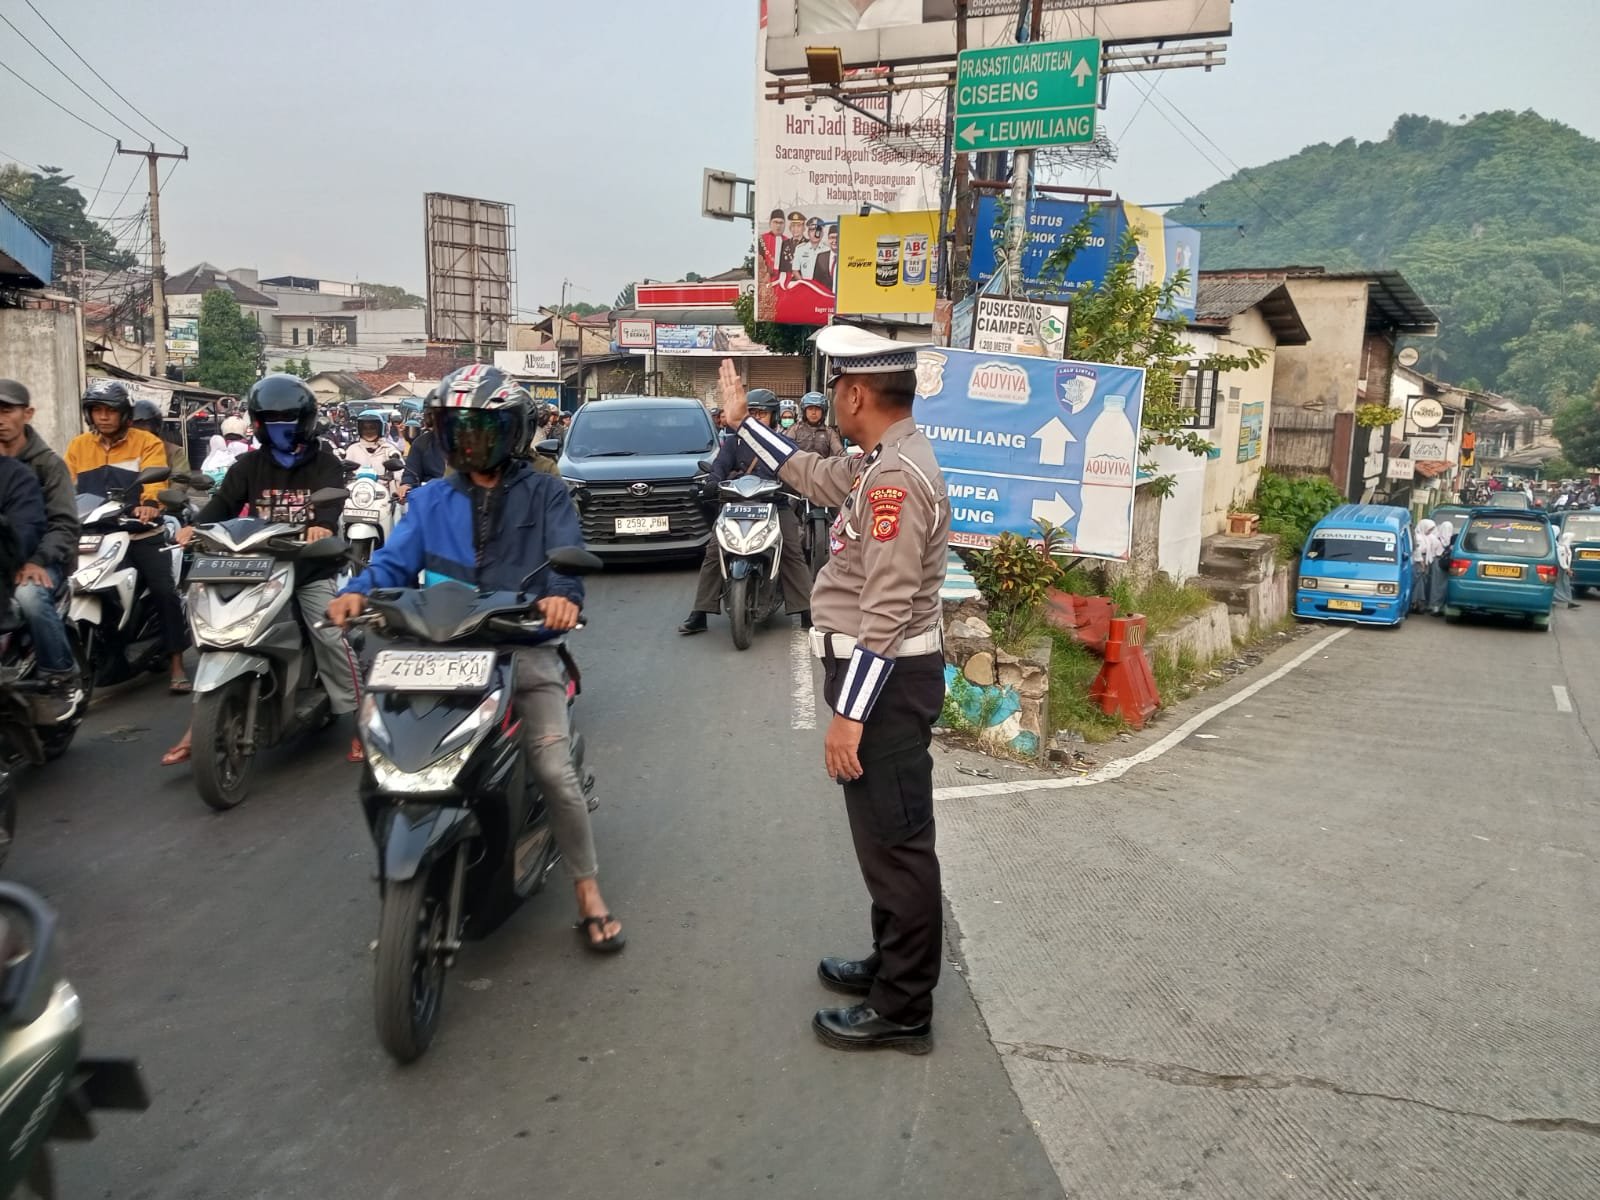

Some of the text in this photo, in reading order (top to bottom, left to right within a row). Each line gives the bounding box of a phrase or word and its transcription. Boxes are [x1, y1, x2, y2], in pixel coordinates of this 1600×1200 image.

[961, 56, 1010, 79] PRASASTI
[959, 81, 1038, 105] CISEENG
[786, 114, 814, 136] Hari
[818, 115, 846, 136] Jadi
[990, 116, 1089, 142] LEUWILIANG
[775, 145, 832, 163] Sacangreud
[834, 145, 869, 163] Pageuh
[873, 188, 897, 201] Bogor
[1030, 215, 1063, 227] SITUS
[878, 249, 897, 258] ABC
[905, 241, 927, 251] ABC
[979, 301, 1042, 321] PUSKESMAS
[977, 318, 1034, 336] CIAMPEA
[972, 371, 1026, 392] AQUVIVA
[1086, 459, 1131, 476] AQUVIVA
[948, 484, 1000, 501] MPEA
[617, 519, 623, 529] B
[627, 518, 647, 528] 2592
[951, 508, 994, 523] UNG
